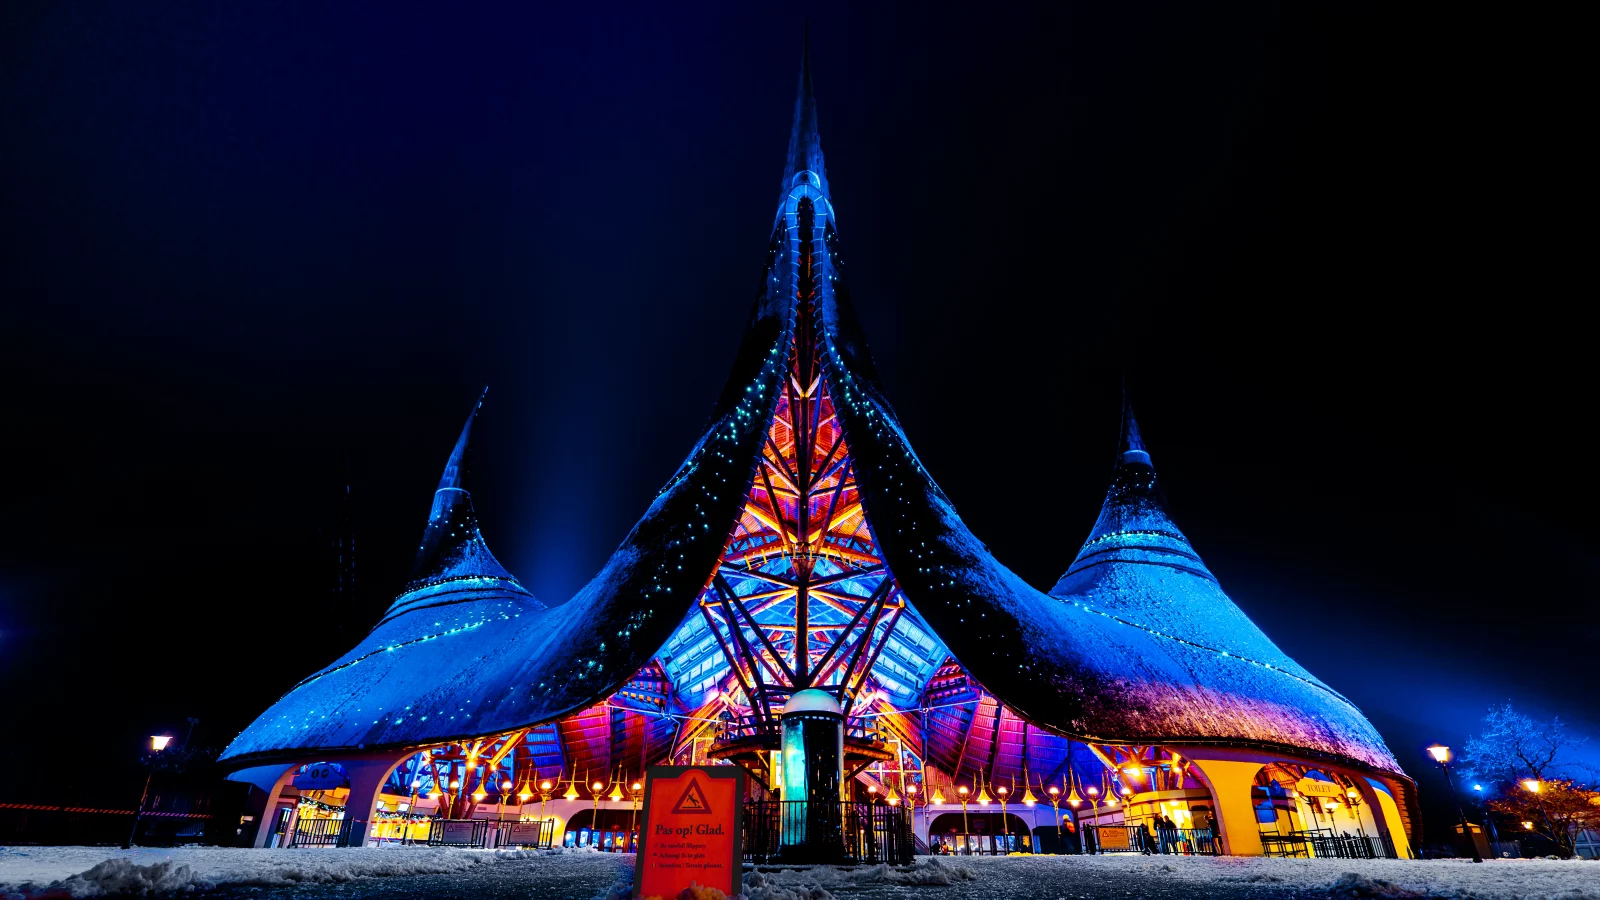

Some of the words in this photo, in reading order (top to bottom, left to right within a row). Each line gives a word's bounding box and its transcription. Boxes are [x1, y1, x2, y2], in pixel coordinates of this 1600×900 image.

[1305, 784, 1331, 792] TOILET
[655, 824, 673, 835] Pas
[675, 824, 693, 838] op!
[696, 824, 725, 835] Glad.
